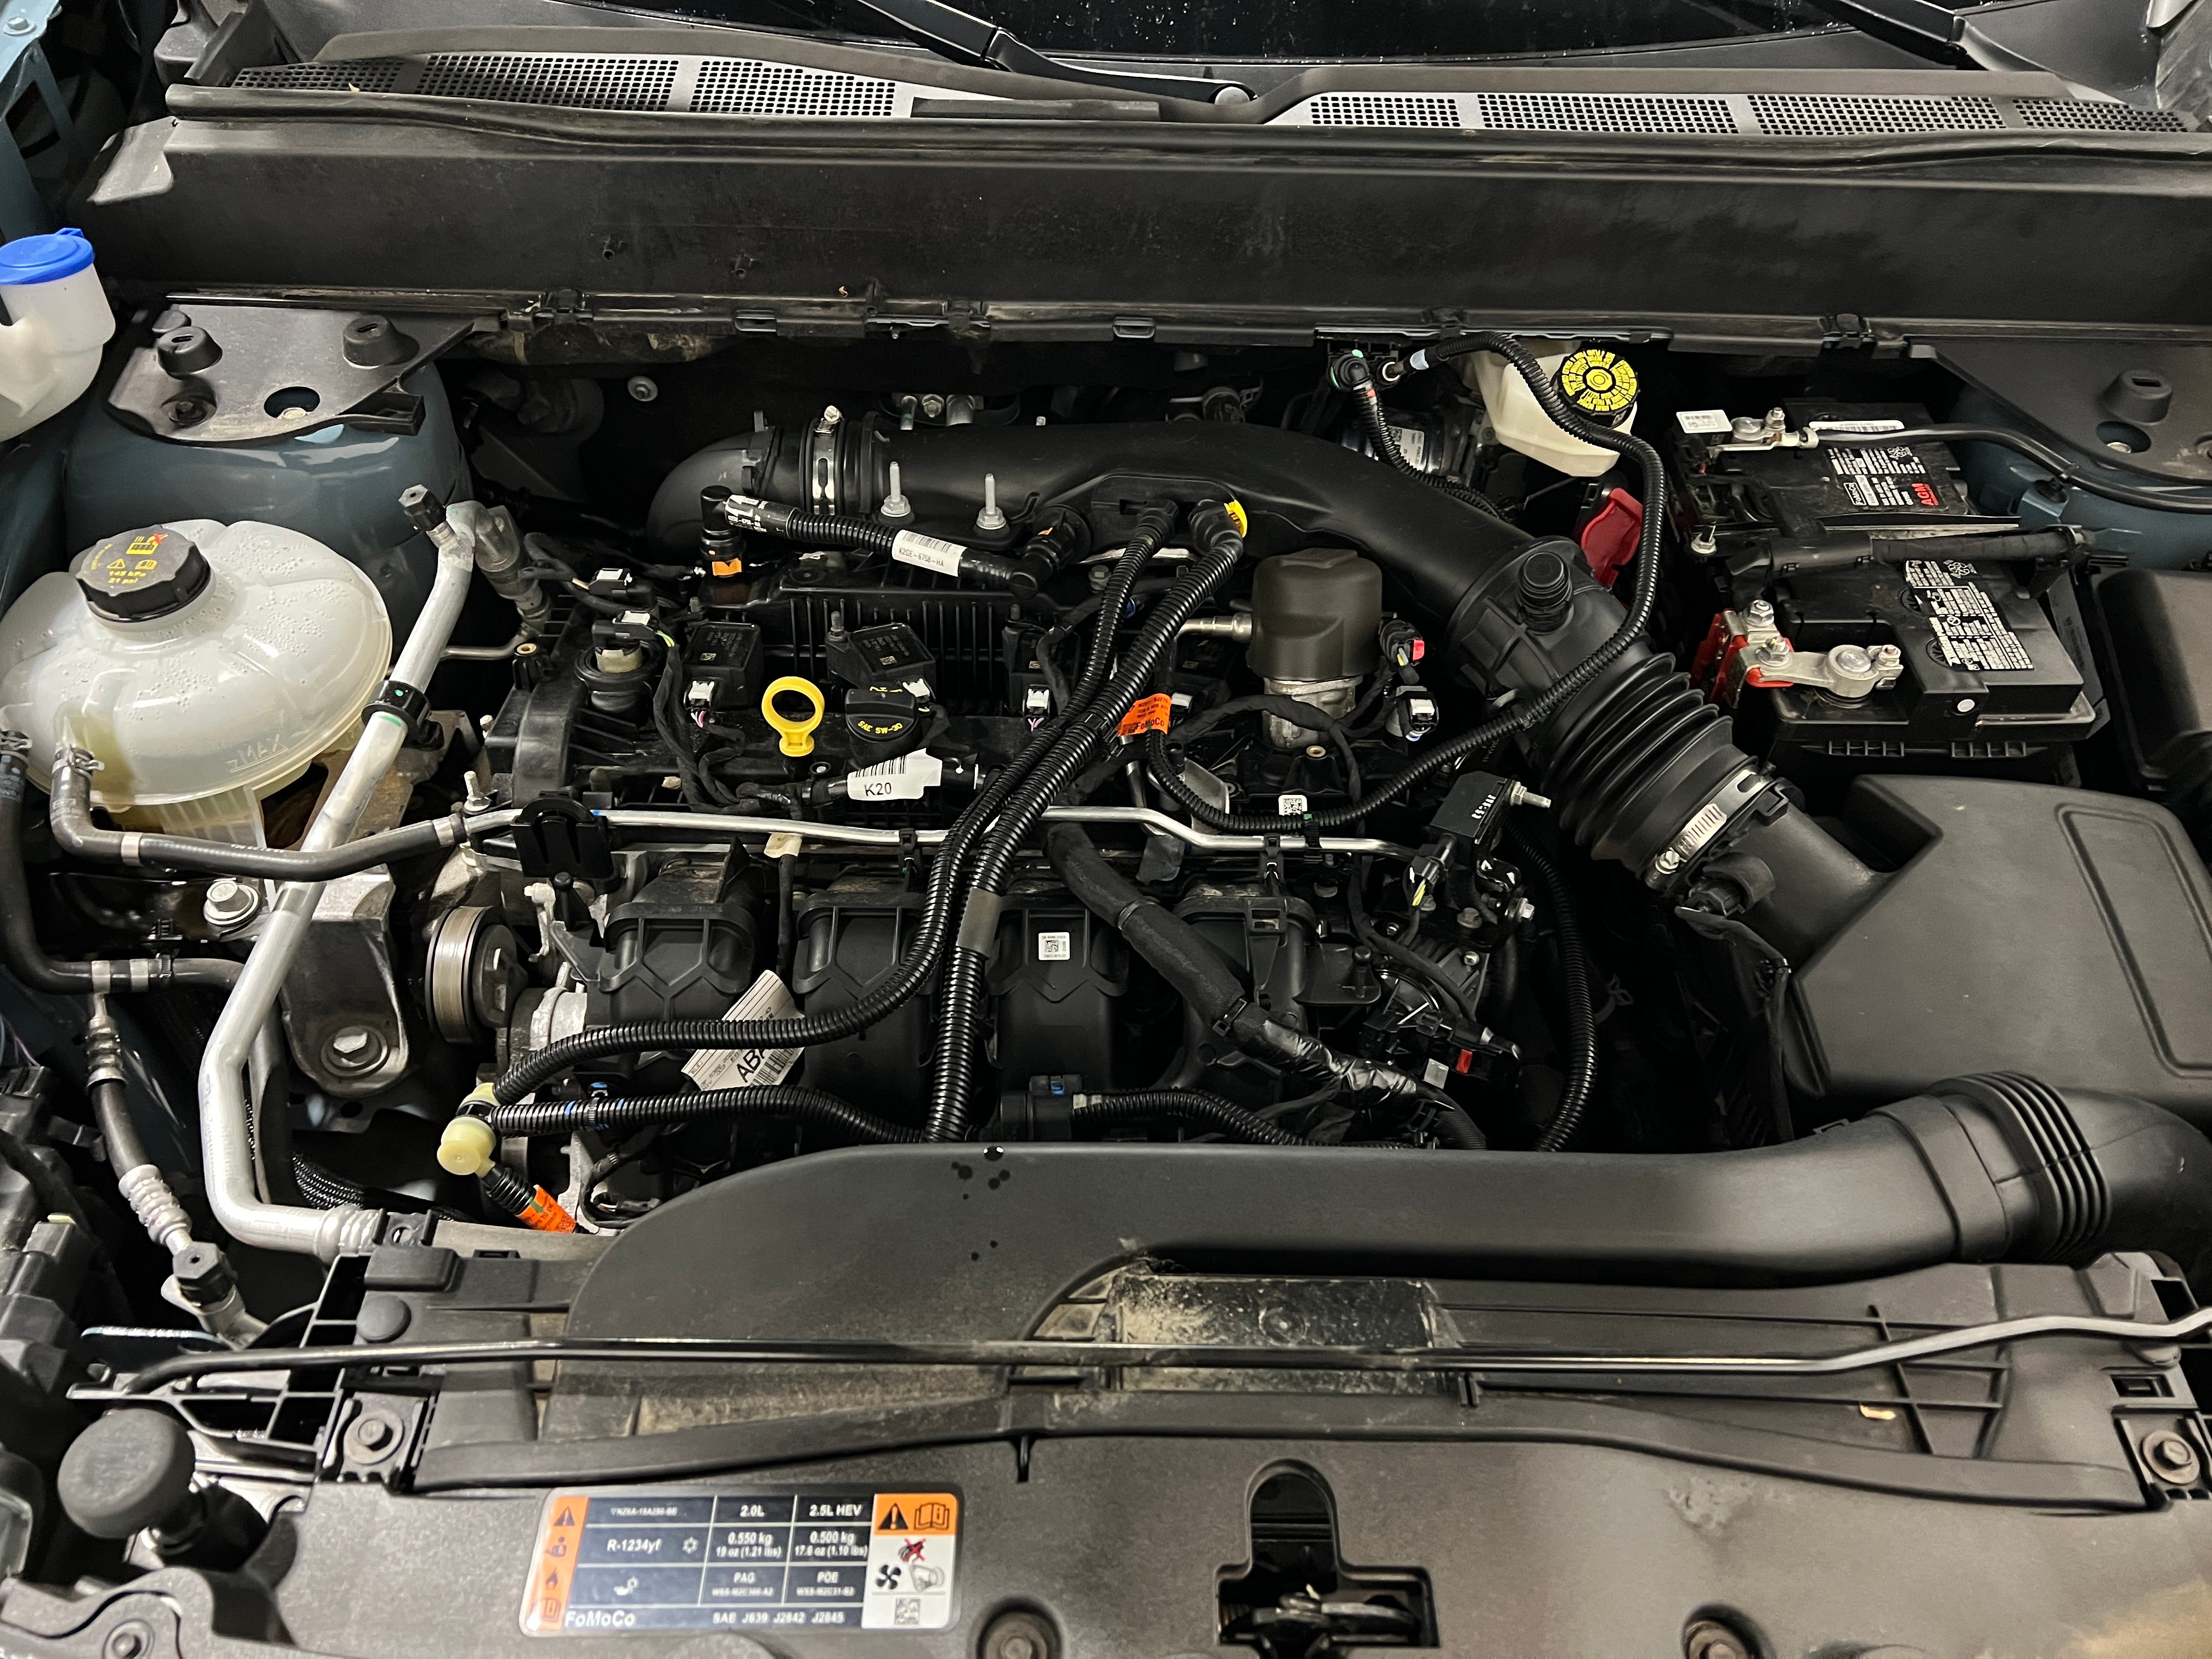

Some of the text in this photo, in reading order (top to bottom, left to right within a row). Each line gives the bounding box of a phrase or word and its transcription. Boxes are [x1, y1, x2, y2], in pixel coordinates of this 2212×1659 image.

[1911, 483, 1934, 505] AGM
[857, 720, 903, 734] SAE 5W-30
[865, 782, 891, 797] K20
[740, 1504, 765, 1517] 2.0L
[809, 1504, 862, 1517] 2.5L HEV
[728, 1532, 774, 1547] 0.550 kg
[810, 1531, 856, 1546] 0.500 kg
[607, 1538, 662, 1555] R-1234yf
[716, 1545, 782, 1559] 19 oz (1.21 lbs)
[814, 1547, 826, 1556] oz
[827, 1545, 849, 1558] (1.10
[851, 1545, 868, 1559] lbs)
[733, 1572, 757, 1583] PAG
[817, 1571, 839, 1583] POE
[565, 1610, 636, 1627] FoMoCo
[713, 1612, 737, 1624] SAE
[742, 1612, 769, 1624] J639
